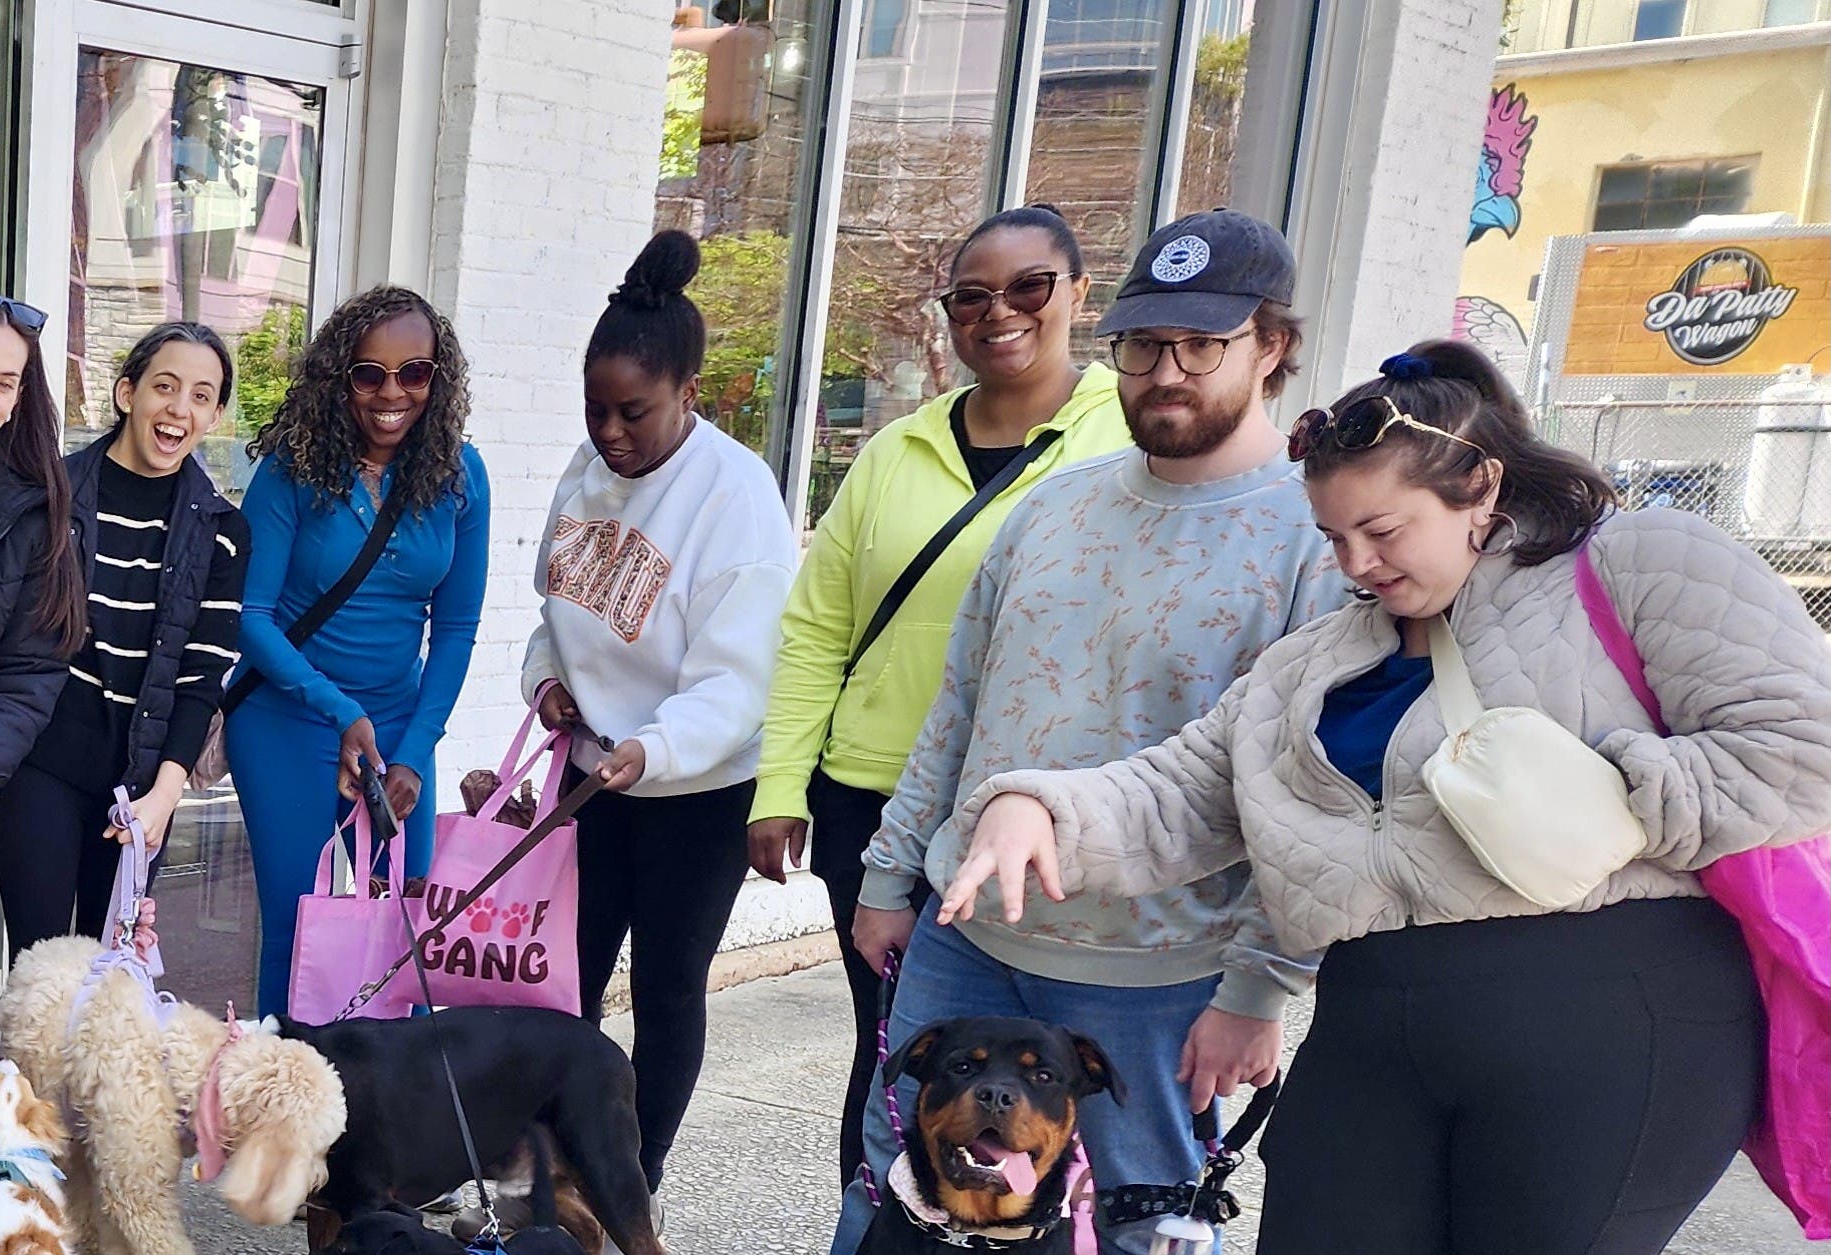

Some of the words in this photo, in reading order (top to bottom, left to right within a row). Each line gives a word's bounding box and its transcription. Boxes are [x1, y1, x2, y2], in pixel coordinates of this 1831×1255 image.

[1645, 291, 1708, 331] Da
[1710, 283, 1798, 320] Patty
[1674, 317, 1759, 349] Wagon
[418, 928, 549, 984] GANG
